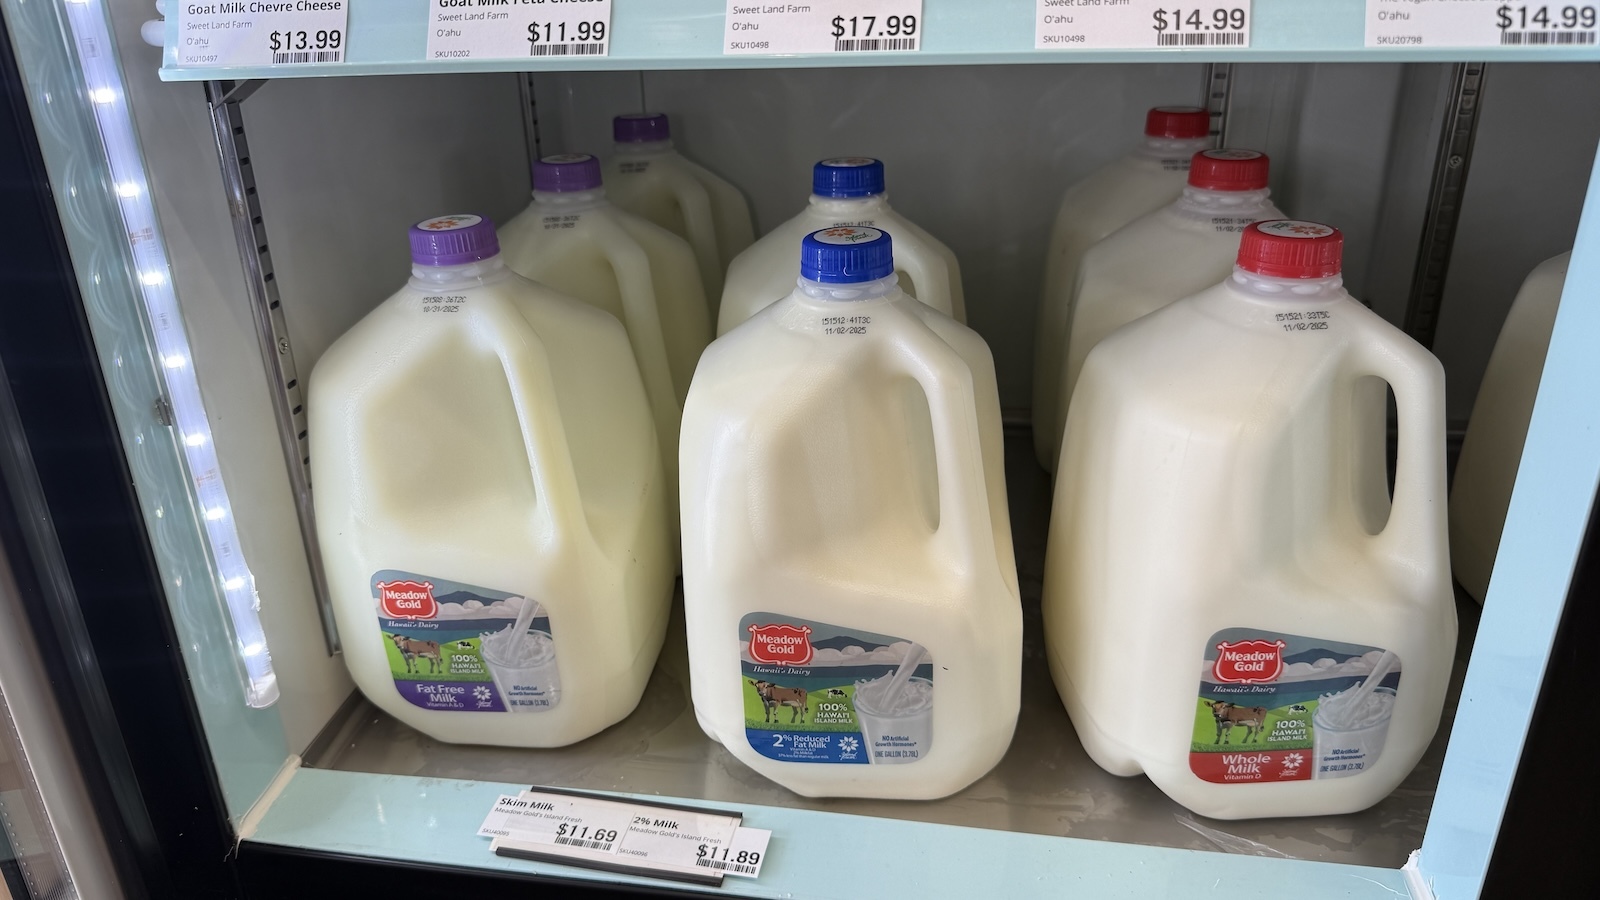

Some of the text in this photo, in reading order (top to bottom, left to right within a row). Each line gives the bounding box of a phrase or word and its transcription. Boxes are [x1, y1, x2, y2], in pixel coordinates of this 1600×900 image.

[188, 0, 341, 15] Goat Milk Chevre Cheese
[733, 4, 811, 15] Sweet Land Farm
[437, 11, 509, 22] Sweet Land Farm
[1044, 15, 1073, 24] O'ahu
[1152, 8, 1245, 33] $14.99
[1377, 11, 1410, 21] O'ahu
[1496, 5, 1597, 32] $14.99
[187, 21, 252, 30] Sweet Land Farm
[732, 21, 759, 31] O'ahu
[831, 15, 916, 39] $17.99
[527, 21, 606, 45] $11.99
[269, 30, 342, 52] $13.99
[1043, 35, 1085, 43] SKU10498
[1376, 36, 1423, 45] SKU20798
[730, 41, 770, 50] SKU10498
[185, 55, 218, 63] SKU10497
[435, 50, 470, 58] SKU10202
[825, 327, 867, 335] 11/02/2025
[1283, 322, 1329, 332] 11/02/2025
[385, 590, 428, 600] Meadow
[396, 600, 422, 609] Gold
[757, 634, 804, 645] Meadow
[767, 644, 795, 654] Gold
[451, 655, 478, 663] 100%
[1225, 651, 1276, 661] Meadow
[1234, 662, 1264, 672] Gold
[417, 684, 465, 694] Fat Free
[1251, 685, 1276, 694] Dairy
[430, 694, 457, 703] Milk
[1276, 720, 1305, 729] 100%
[773, 734, 831, 748] 2% Reduced
[1222, 754, 1271, 764] Whole
[1228, 763, 1260, 774] Milk
[1330, 764, 1347, 772] GALLON
[500, 798, 555, 811] Skim Milk
[495, 807, 583, 823] Meadow Gold's Island Fresh
[633, 817, 680, 830] 2% Milk
[482, 828, 510, 837] SKU40095
[556, 823, 618, 842] $11.69
[630, 826, 722, 844] Meadow Gold's Island Fresh
[619, 848, 649, 858] SKU40096
[696, 843, 760, 865] $11.89
